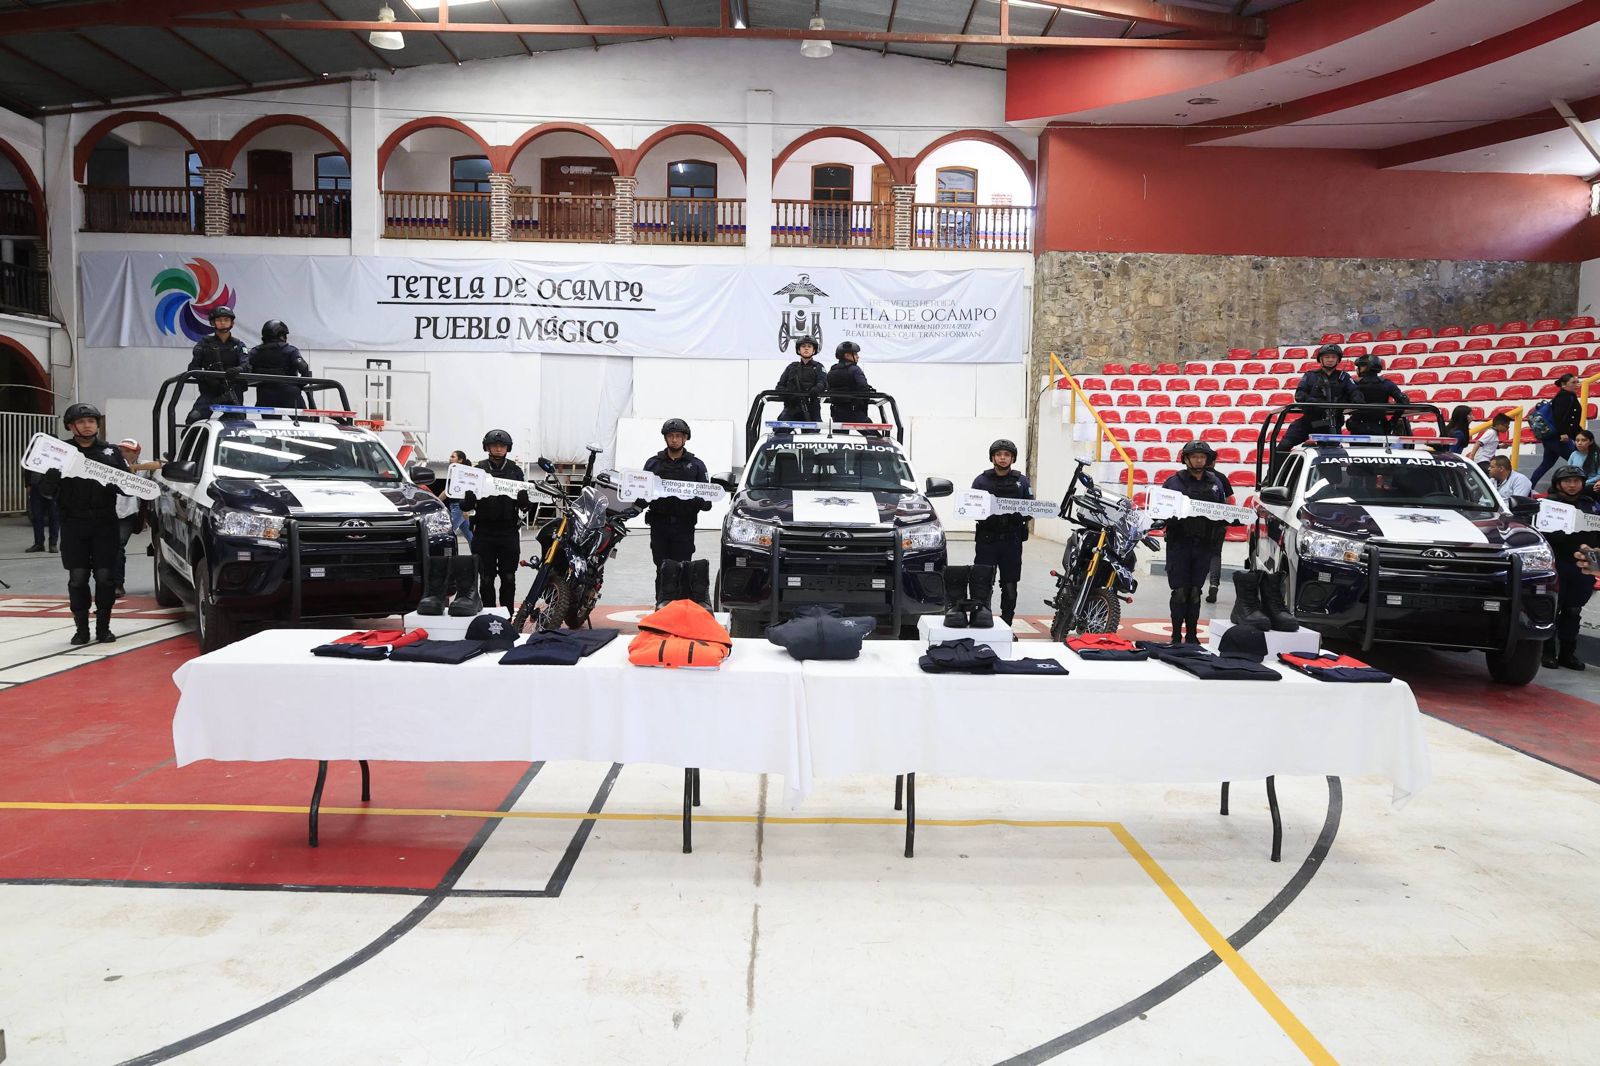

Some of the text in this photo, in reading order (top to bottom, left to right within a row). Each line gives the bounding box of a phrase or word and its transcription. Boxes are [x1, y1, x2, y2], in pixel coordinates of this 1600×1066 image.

[830, 307, 997, 322] TETELA DE OCAMPO
[898, 331, 917, 339] QUE
[84, 459, 157, 490] Entrega de patrullas
[84, 466, 151, 495] Tetela de Ocampo
[662, 480, 685, 488] Entrega
[696, 483, 721, 491] patrullas
[663, 486, 682, 494] Tetela
[692, 488, 719, 497] Ocampo
[1027, 506, 1053, 514] Ocampo
[1190, 500, 1215, 509] Entrega
[1225, 505, 1253, 514] patrullas
[1192, 506, 1212, 514] Tetela
[1213, 508, 1222, 516] de
[1222, 511, 1250, 520] Ocampo
